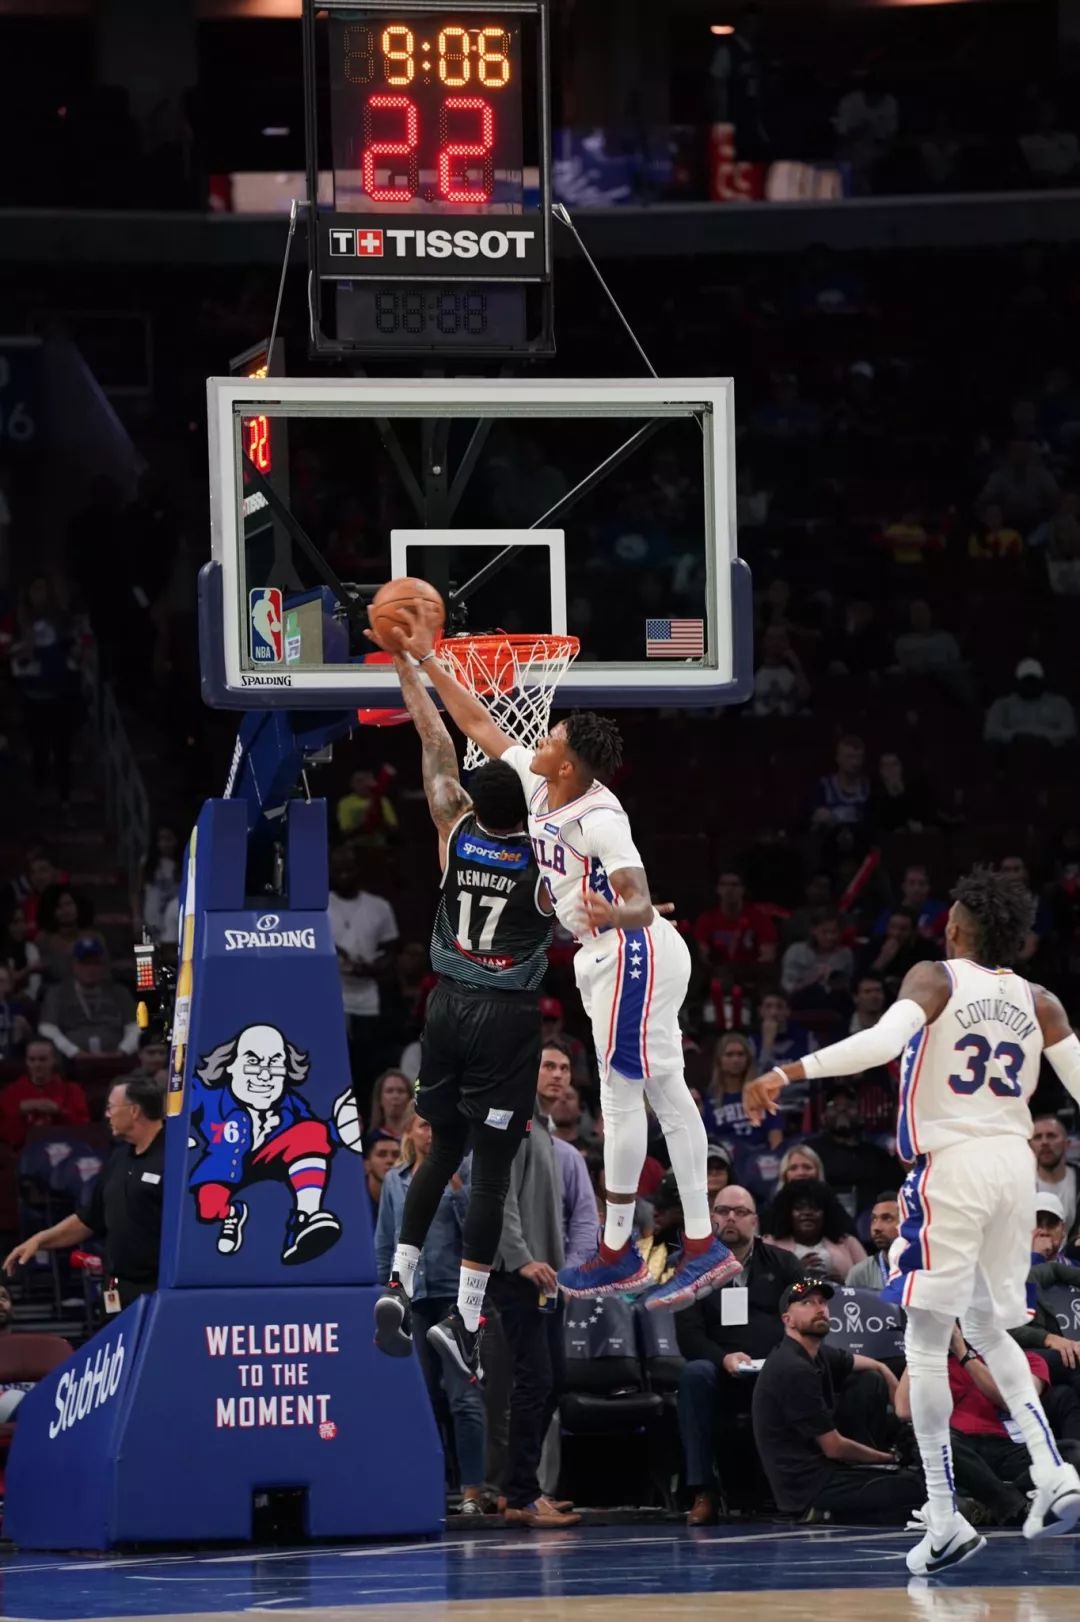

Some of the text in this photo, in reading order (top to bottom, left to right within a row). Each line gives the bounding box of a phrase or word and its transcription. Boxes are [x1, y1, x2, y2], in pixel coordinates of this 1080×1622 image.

[382, 26, 510, 87] 9:06
[363, 96, 493, 202] 22
[387, 230, 534, 258] TISSOT
[255, 646, 271, 659] NBA
[241, 675, 292, 687] SPALDING
[462, 841, 522, 863] sportsbet
[456, 869, 517, 894] KENNEDY
[456, 890, 508, 951] 17
[224, 928, 316, 951] SPALDING
[954, 998, 1038, 1041] COVINGTON
[948, 1033, 1026, 1098] 33
[210, 1120, 240, 1144] 76
[205, 1323, 340, 1356] WELCOME
[49, 1333, 125, 1439] StubHub
[238, 1363, 309, 1387] TO THE
[215, 1394, 331, 1428] MOMENT
